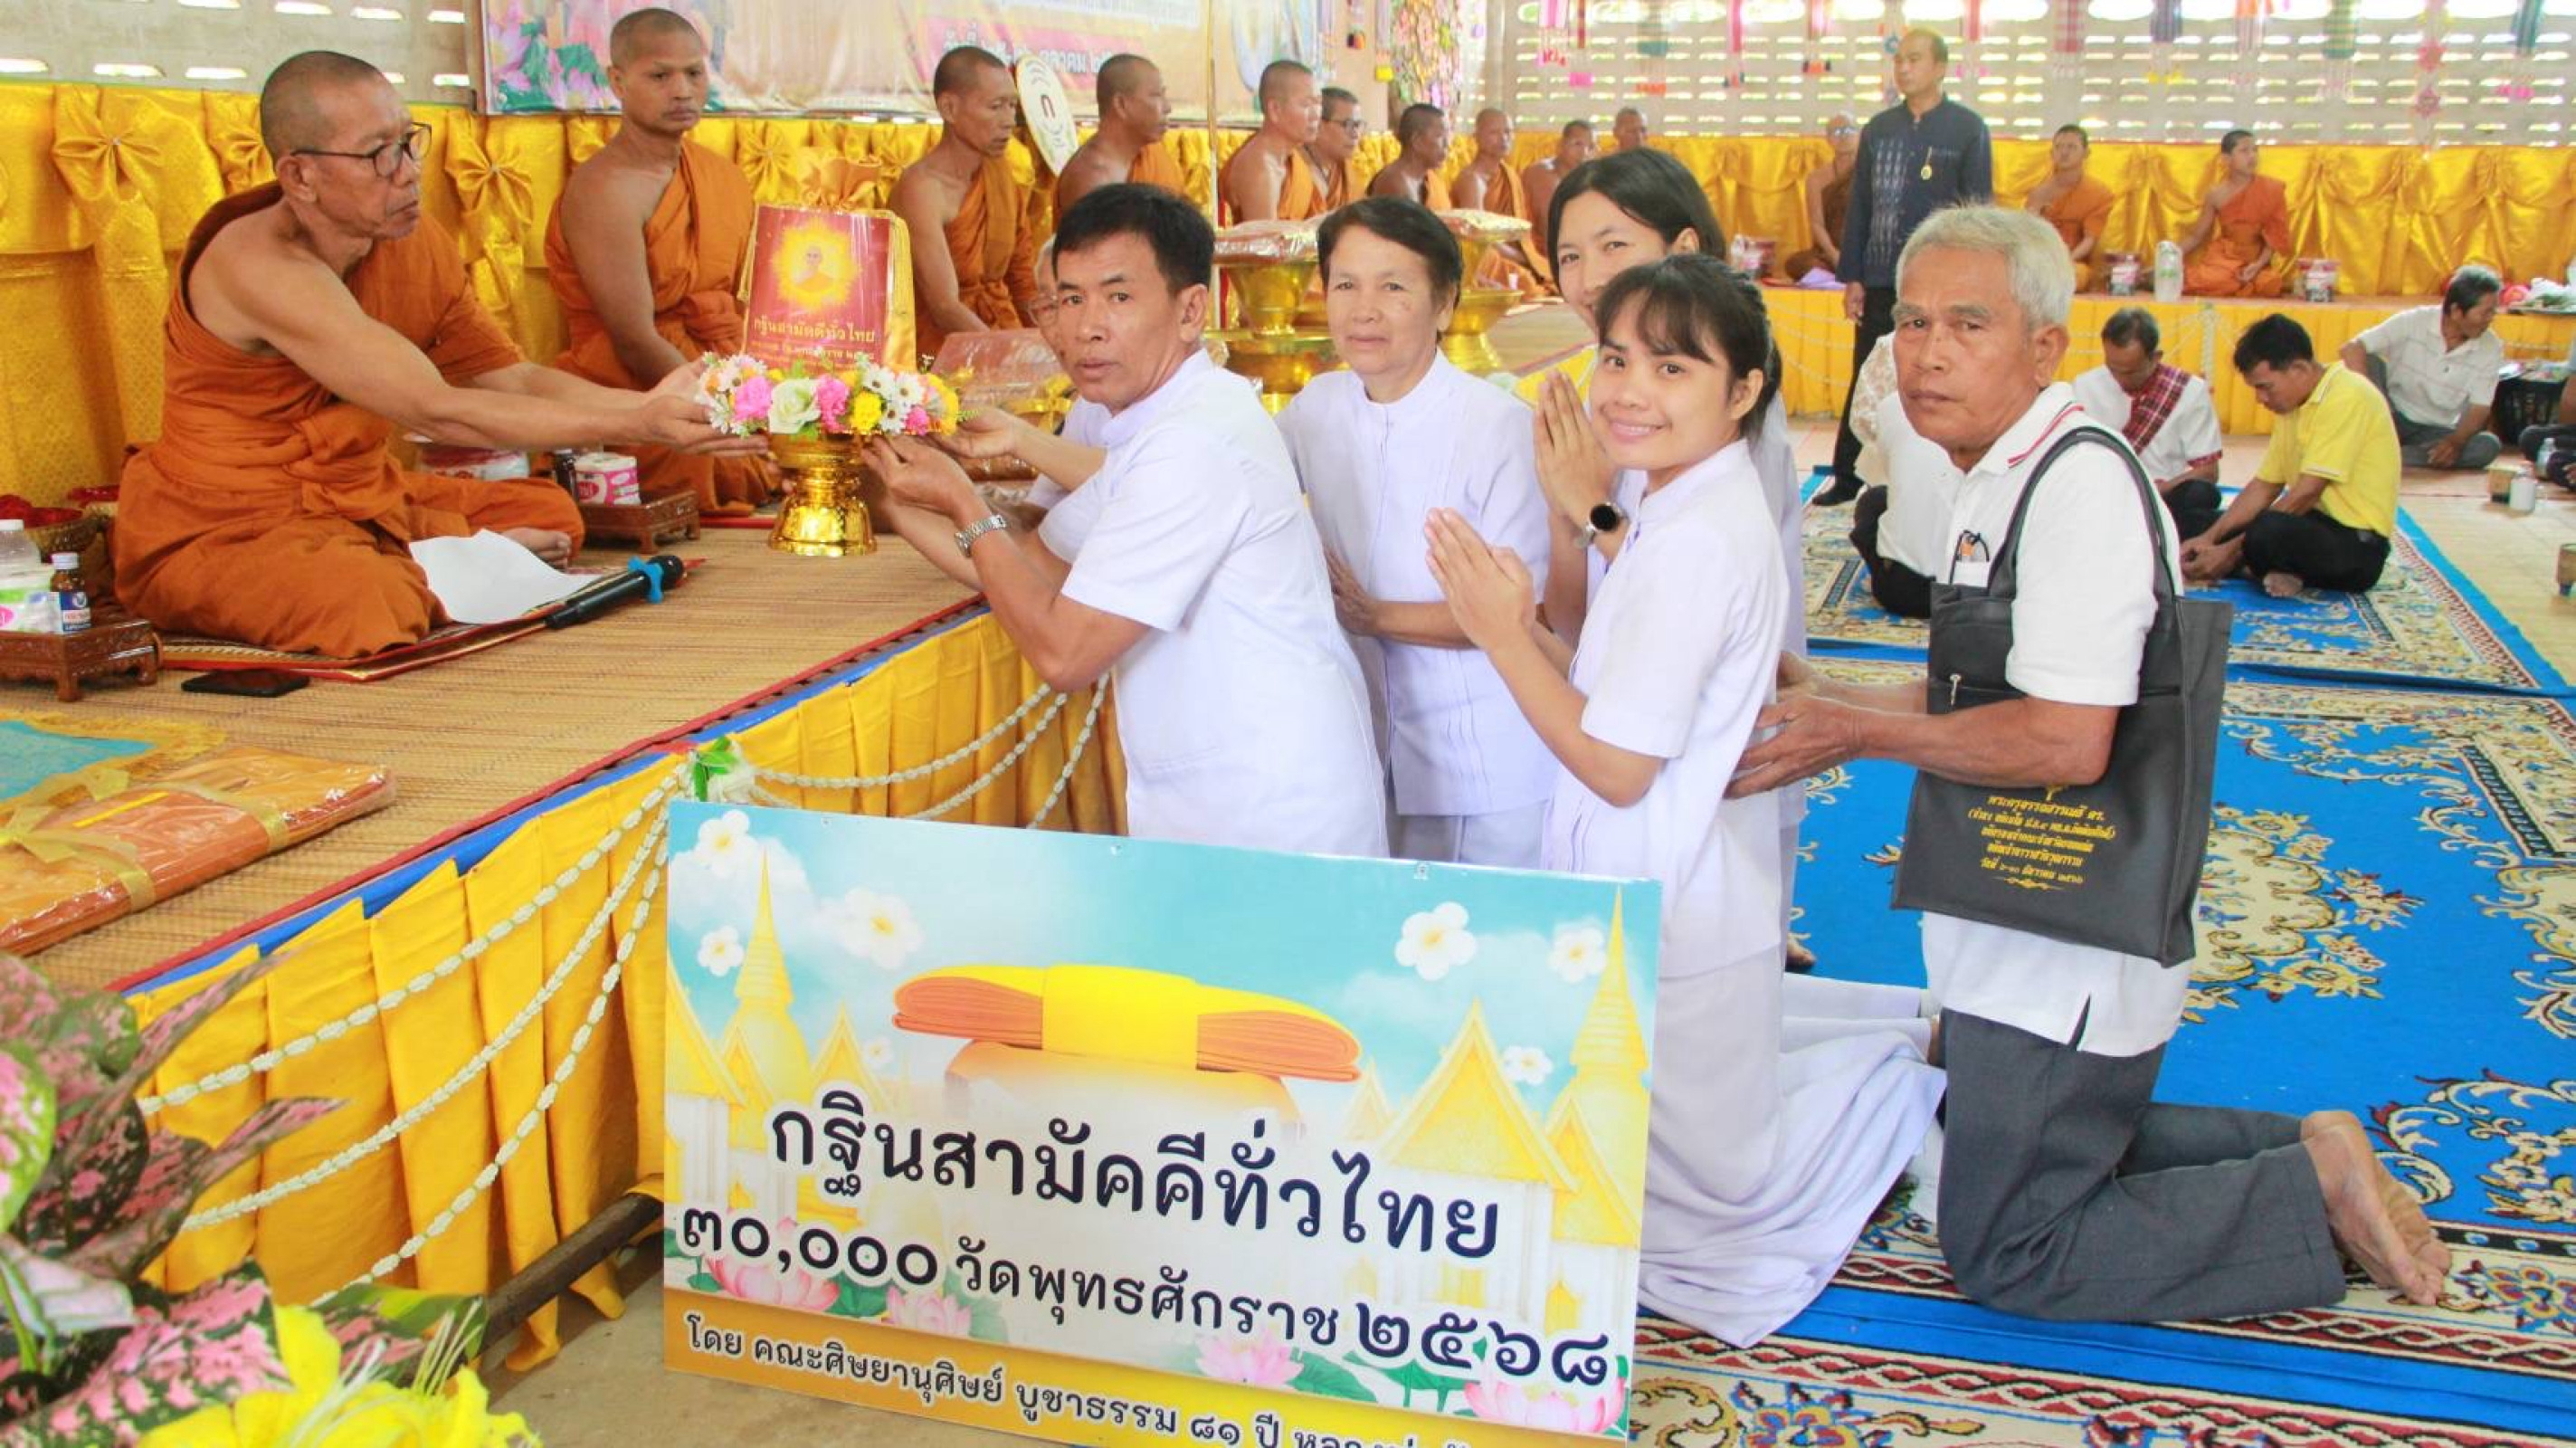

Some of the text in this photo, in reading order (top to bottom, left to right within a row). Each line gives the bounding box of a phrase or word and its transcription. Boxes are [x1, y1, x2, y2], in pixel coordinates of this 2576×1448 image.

[772, 1090, 1498, 1259] กฐินสามัคคีทั่วไทย
[684, 1208, 1609, 1386] ๓๐,๐๐๐ วัดพุทธศักราช ๒๕๖๘
[687, 1314, 743, 1356] โดย
[755, 1338, 1003, 1404] คณะศิษยานุศิษย์
[1016, 1384, 1177, 1434] บูชาธรรม
[1191, 1417, 1240, 1445] ๘๑
[1255, 1414, 1279, 1448] ปี
